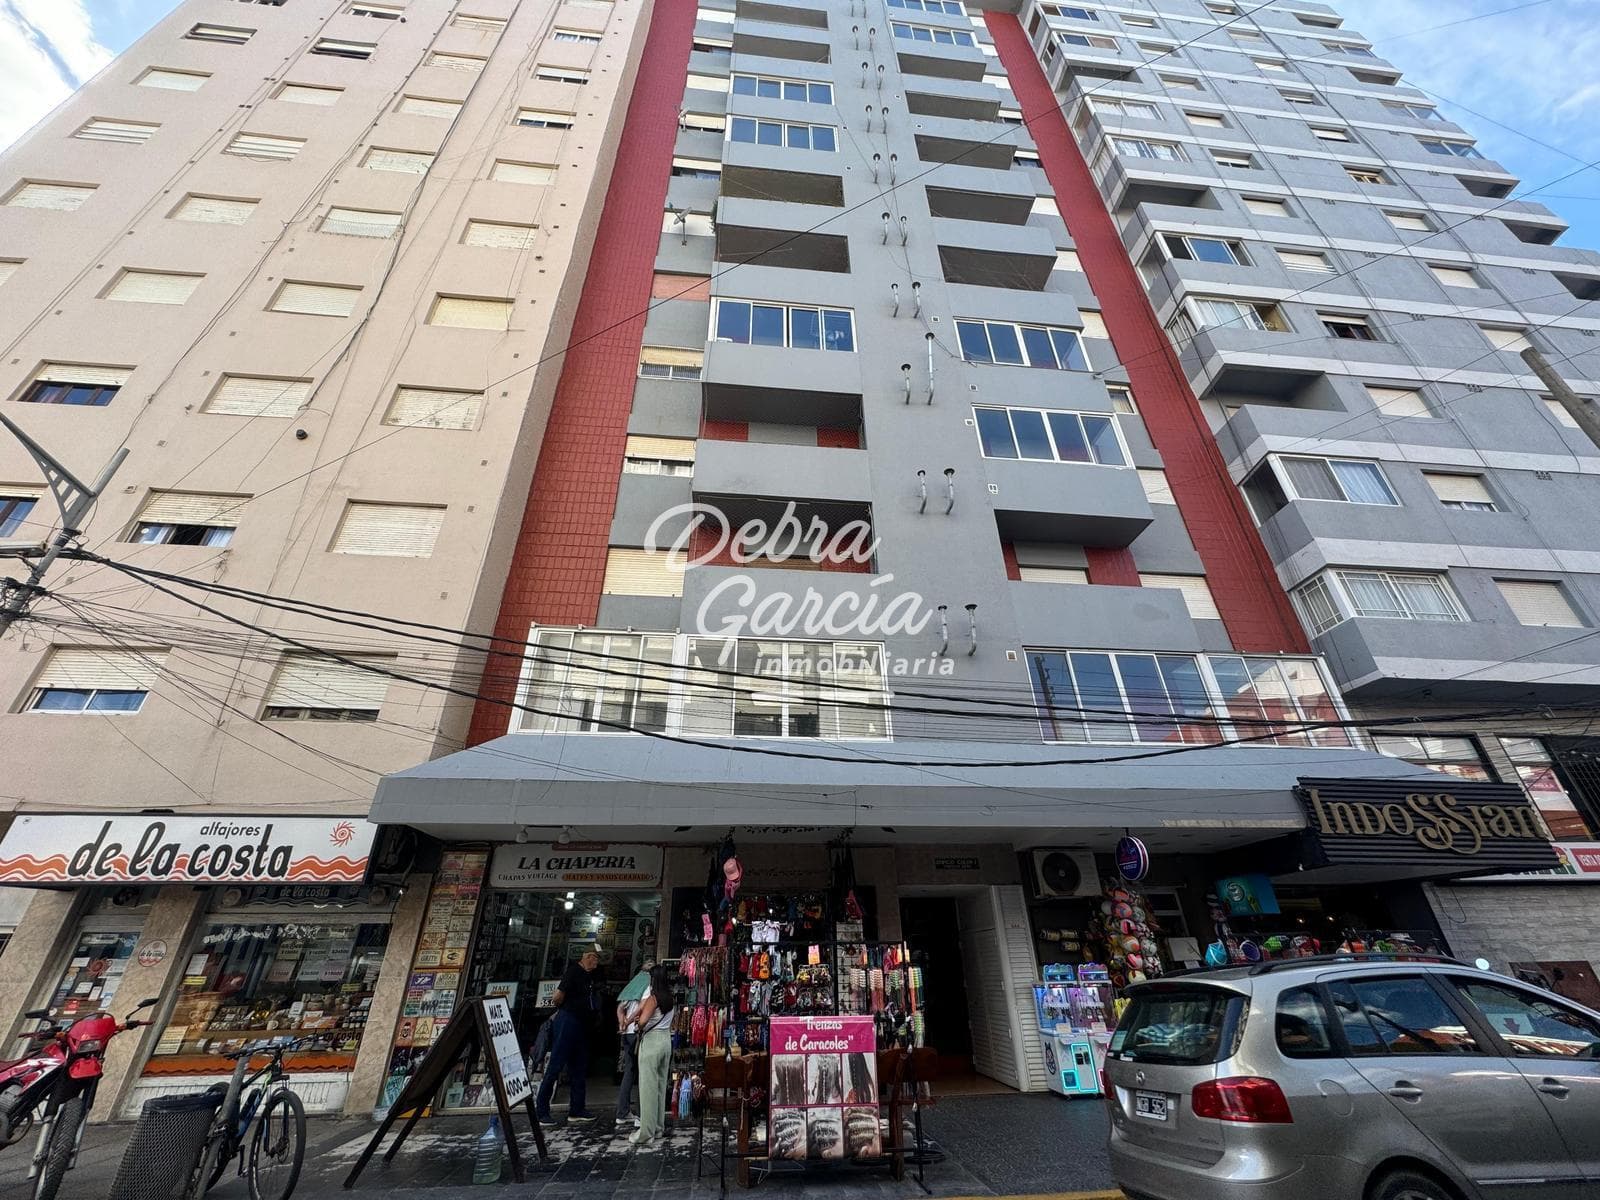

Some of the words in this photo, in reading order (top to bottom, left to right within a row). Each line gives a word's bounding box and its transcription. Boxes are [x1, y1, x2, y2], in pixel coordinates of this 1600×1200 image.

[200, 822, 260, 839] alfajores
[67, 821, 123, 878] de
[128, 822, 182, 877] la
[187, 824, 293, 878] costa
[518, 857, 541, 870] LA
[546, 856, 636, 870] CHAPERIA
[280, 886, 290, 897] de
[306, 887, 330, 897] costa
[488, 1004, 503, 1020] MATE
[785, 1036, 797, 1051] de
